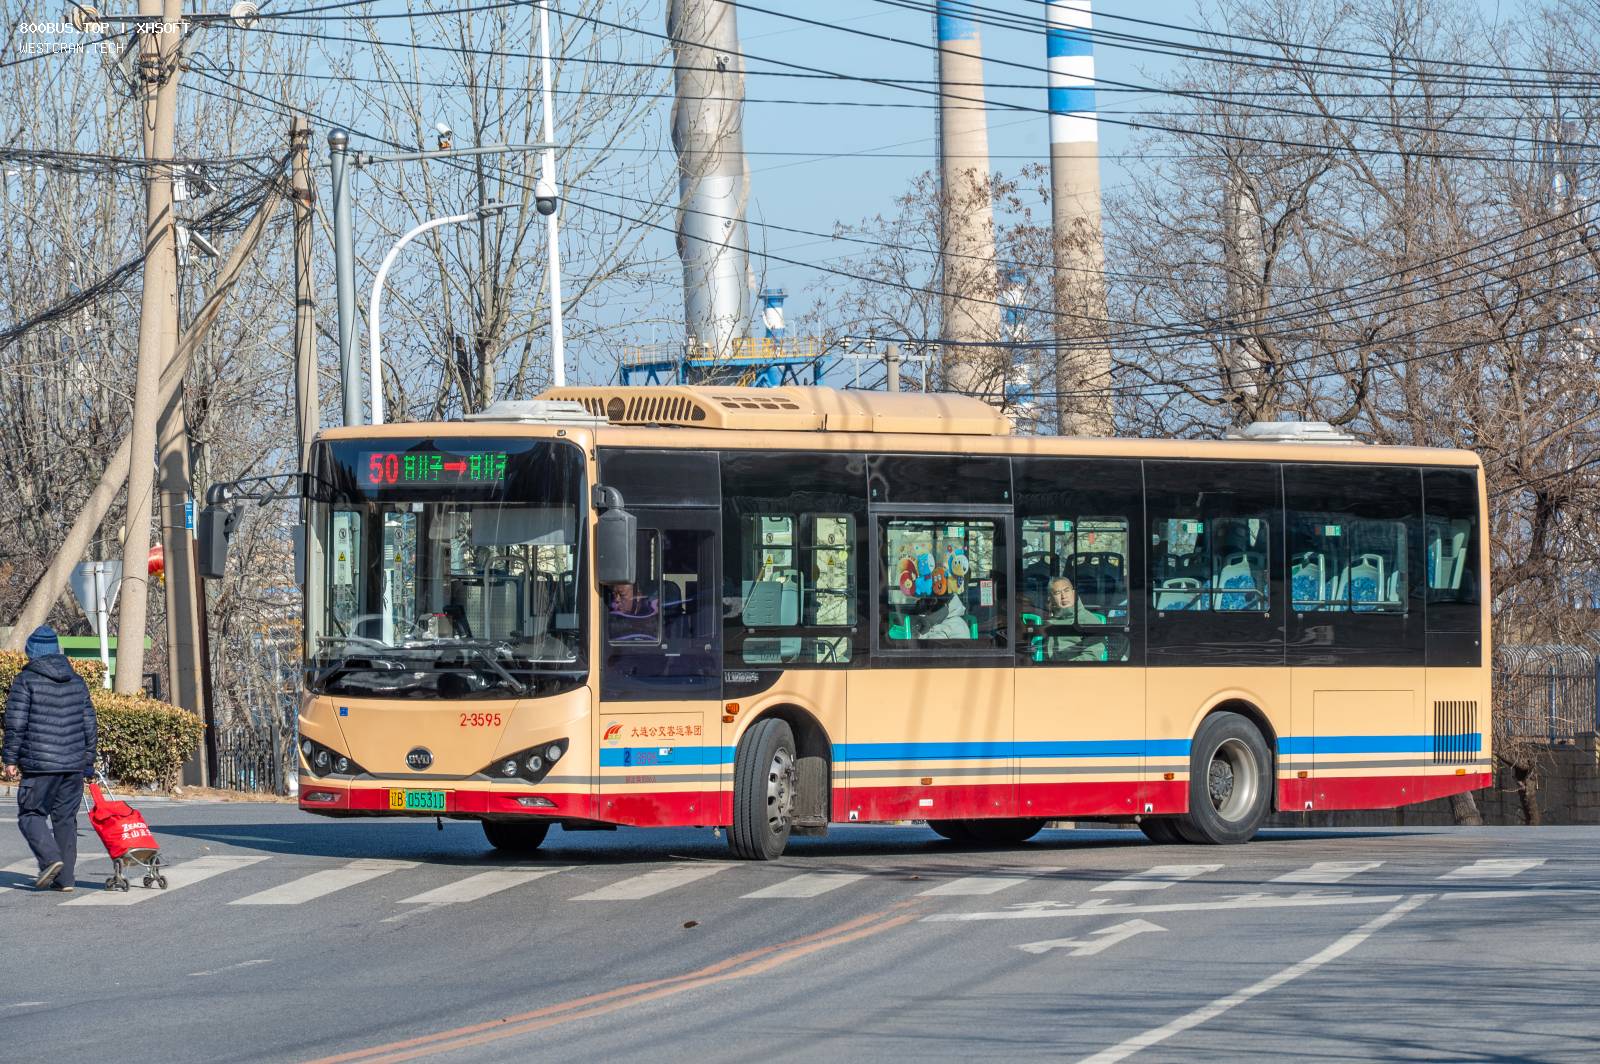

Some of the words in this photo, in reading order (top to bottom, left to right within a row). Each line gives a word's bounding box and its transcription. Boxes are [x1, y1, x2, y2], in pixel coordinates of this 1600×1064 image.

[368, 453, 399, 484] 50
[460, 713, 501, 727] 2-3595
[631, 725, 702, 738] 大连公交客运集团
[408, 754, 430, 765] BYD
